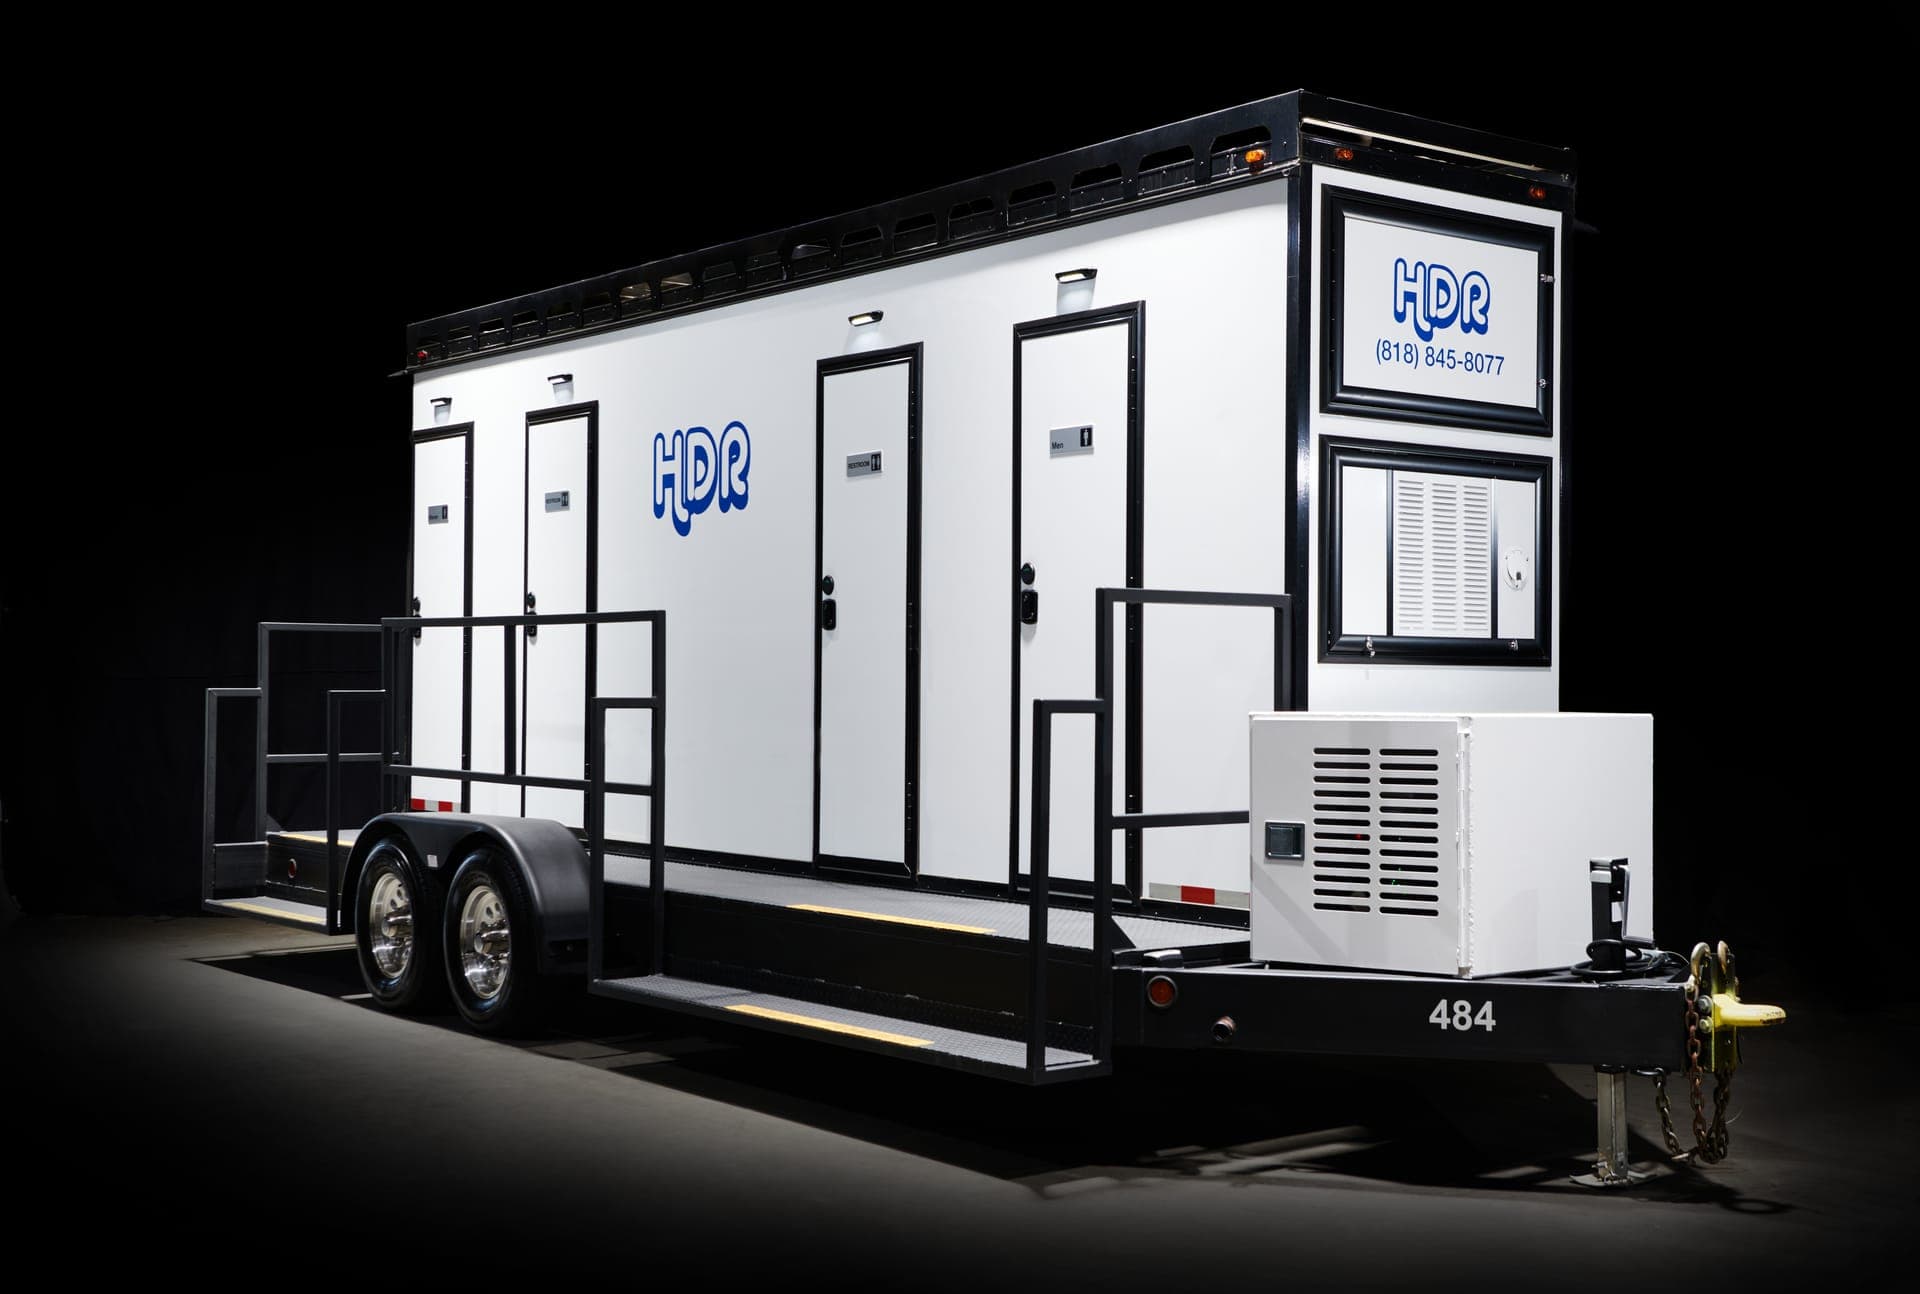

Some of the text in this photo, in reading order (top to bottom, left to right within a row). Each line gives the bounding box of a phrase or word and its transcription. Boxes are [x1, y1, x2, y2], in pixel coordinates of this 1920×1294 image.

[1393, 257, 1490, 342] HDR
[1376, 338, 1505, 376] (818) 845-8077
[1051, 441, 1065, 450] Men
[653, 420, 751, 537] HDR
[1429, 998, 1497, 1032] 484
